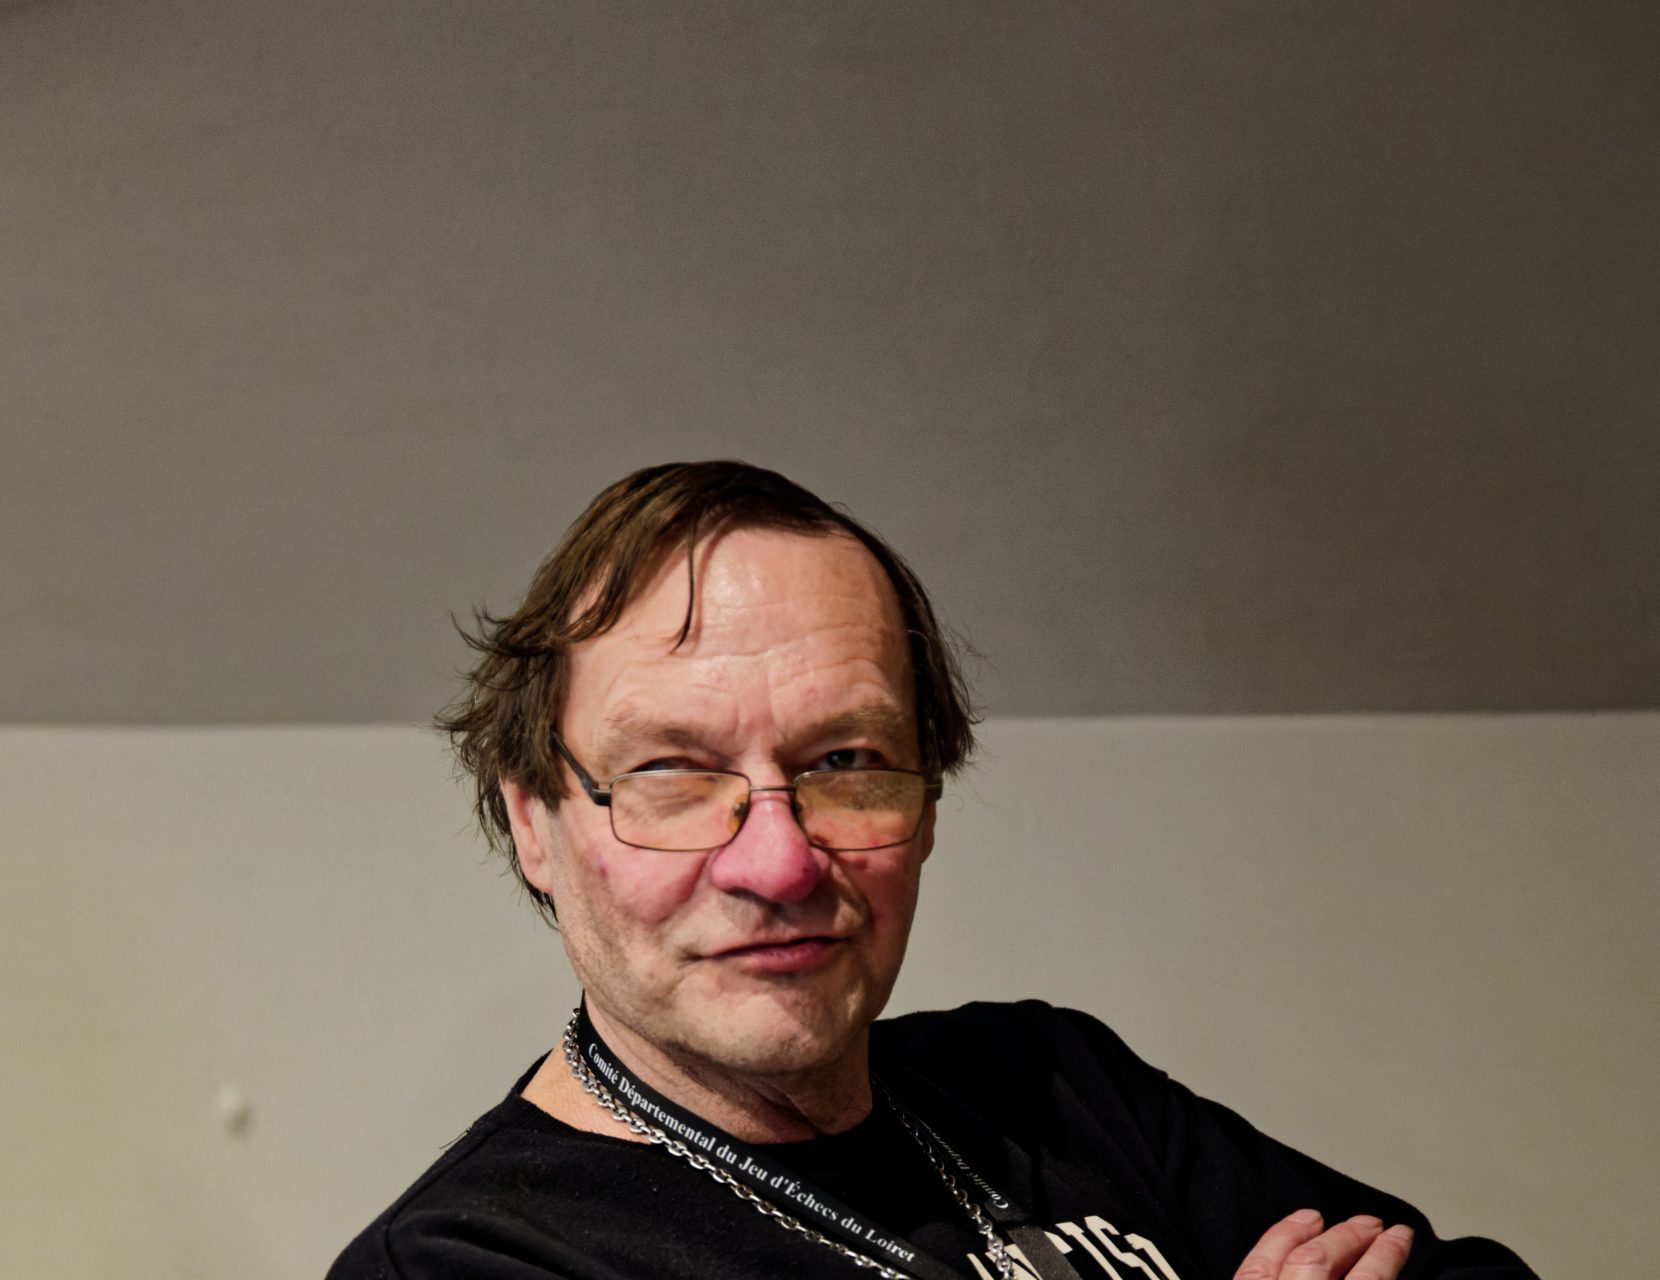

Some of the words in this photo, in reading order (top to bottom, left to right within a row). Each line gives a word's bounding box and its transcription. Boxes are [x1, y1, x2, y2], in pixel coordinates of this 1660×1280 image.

[588, 1042, 619, 1085] Comité
[617, 1076, 717, 1151] Départemental
[716, 1144, 741, 1165] du
[738, 1157, 768, 1181] Jeu
[770, 1175, 839, 1221] d'Échecs
[840, 1216, 863, 1235] du
[865, 1229, 916, 1263] Loiret
